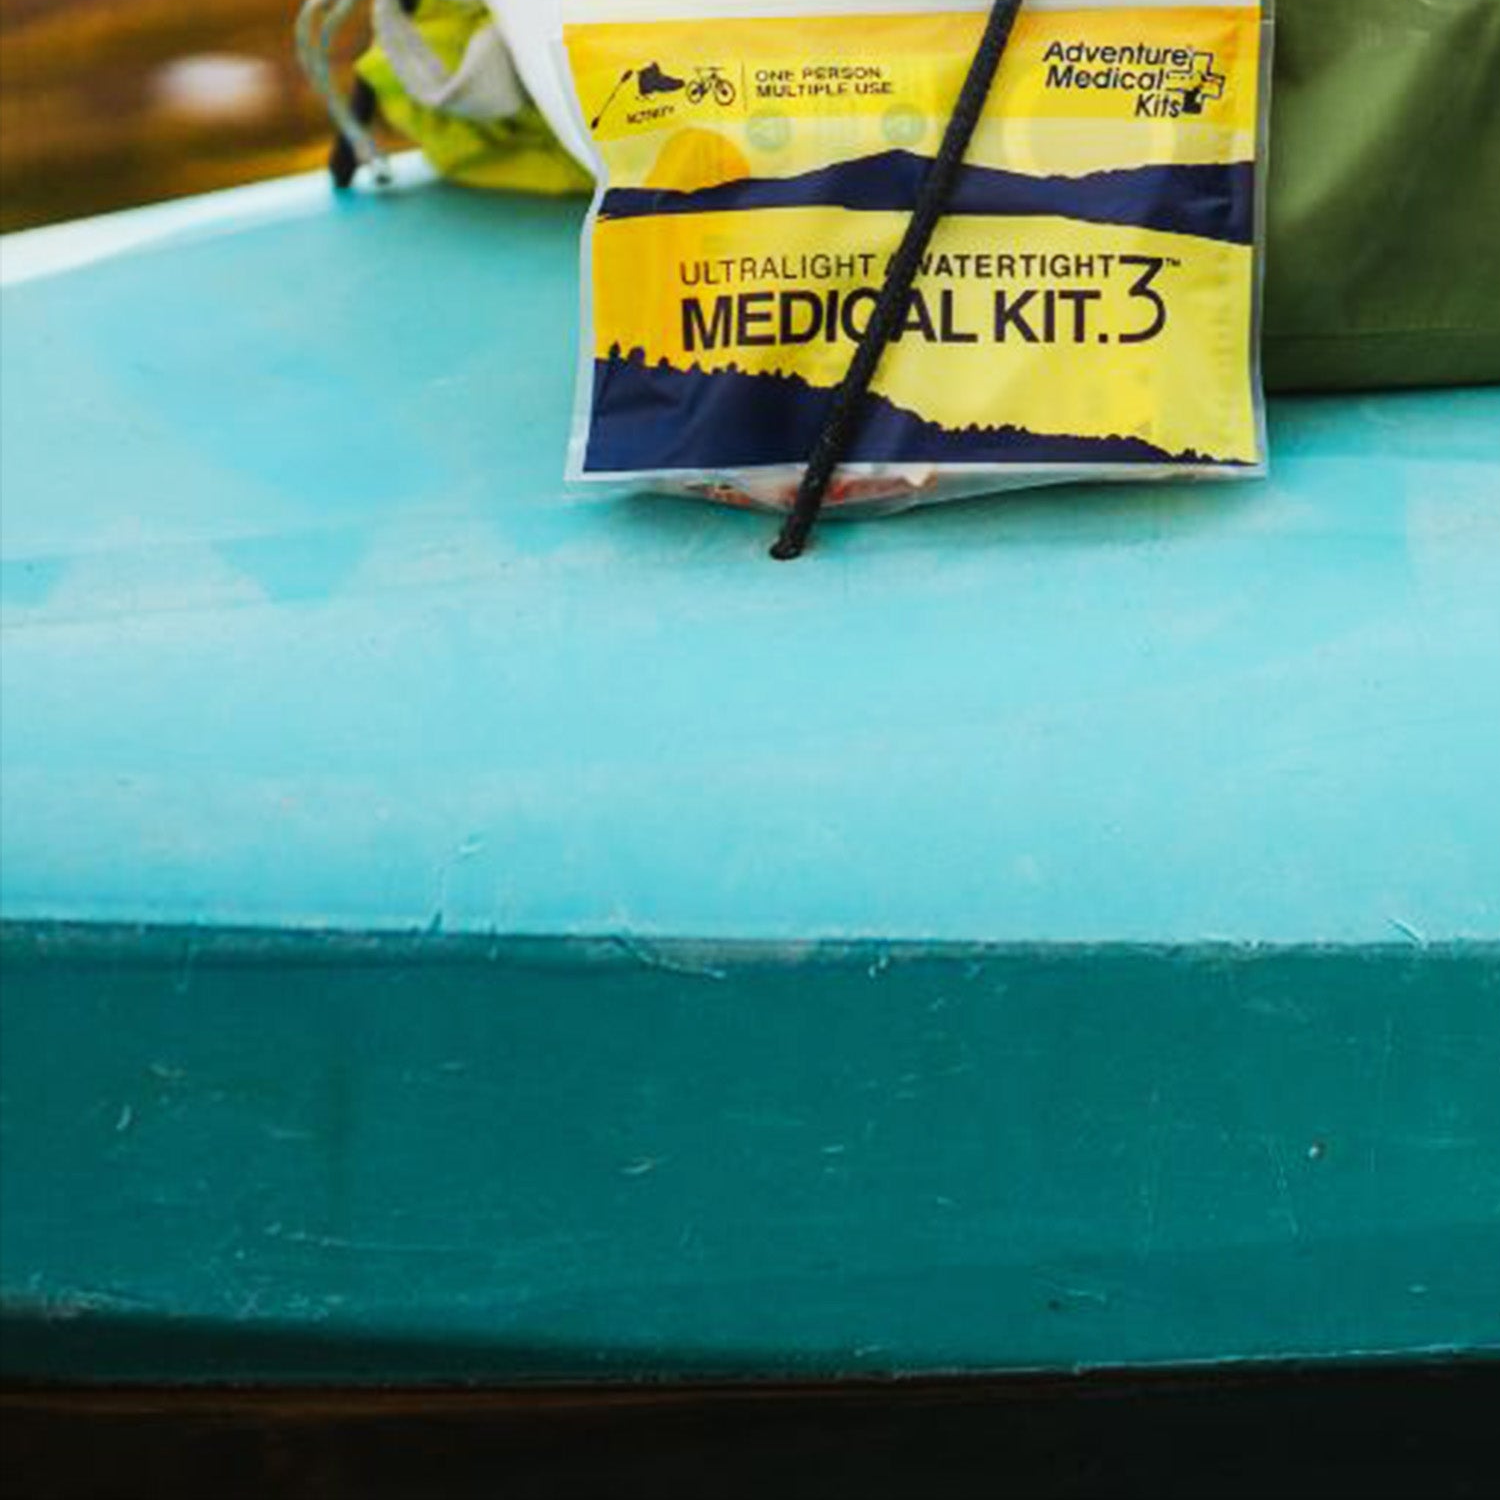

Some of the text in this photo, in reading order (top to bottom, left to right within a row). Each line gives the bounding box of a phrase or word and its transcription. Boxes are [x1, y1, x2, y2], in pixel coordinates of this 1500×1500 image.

[1042, 40, 1189, 66] Adventure
[755, 66, 882, 83] ONE PERSON
[1045, 65, 1164, 91] Medical
[755, 82, 893, 98] MULTIPLE USE
[1134, 94, 1182, 118] Kits
[679, 253, 876, 286] ULTRALIGHT
[681, 287, 978, 352] MEDICAL
